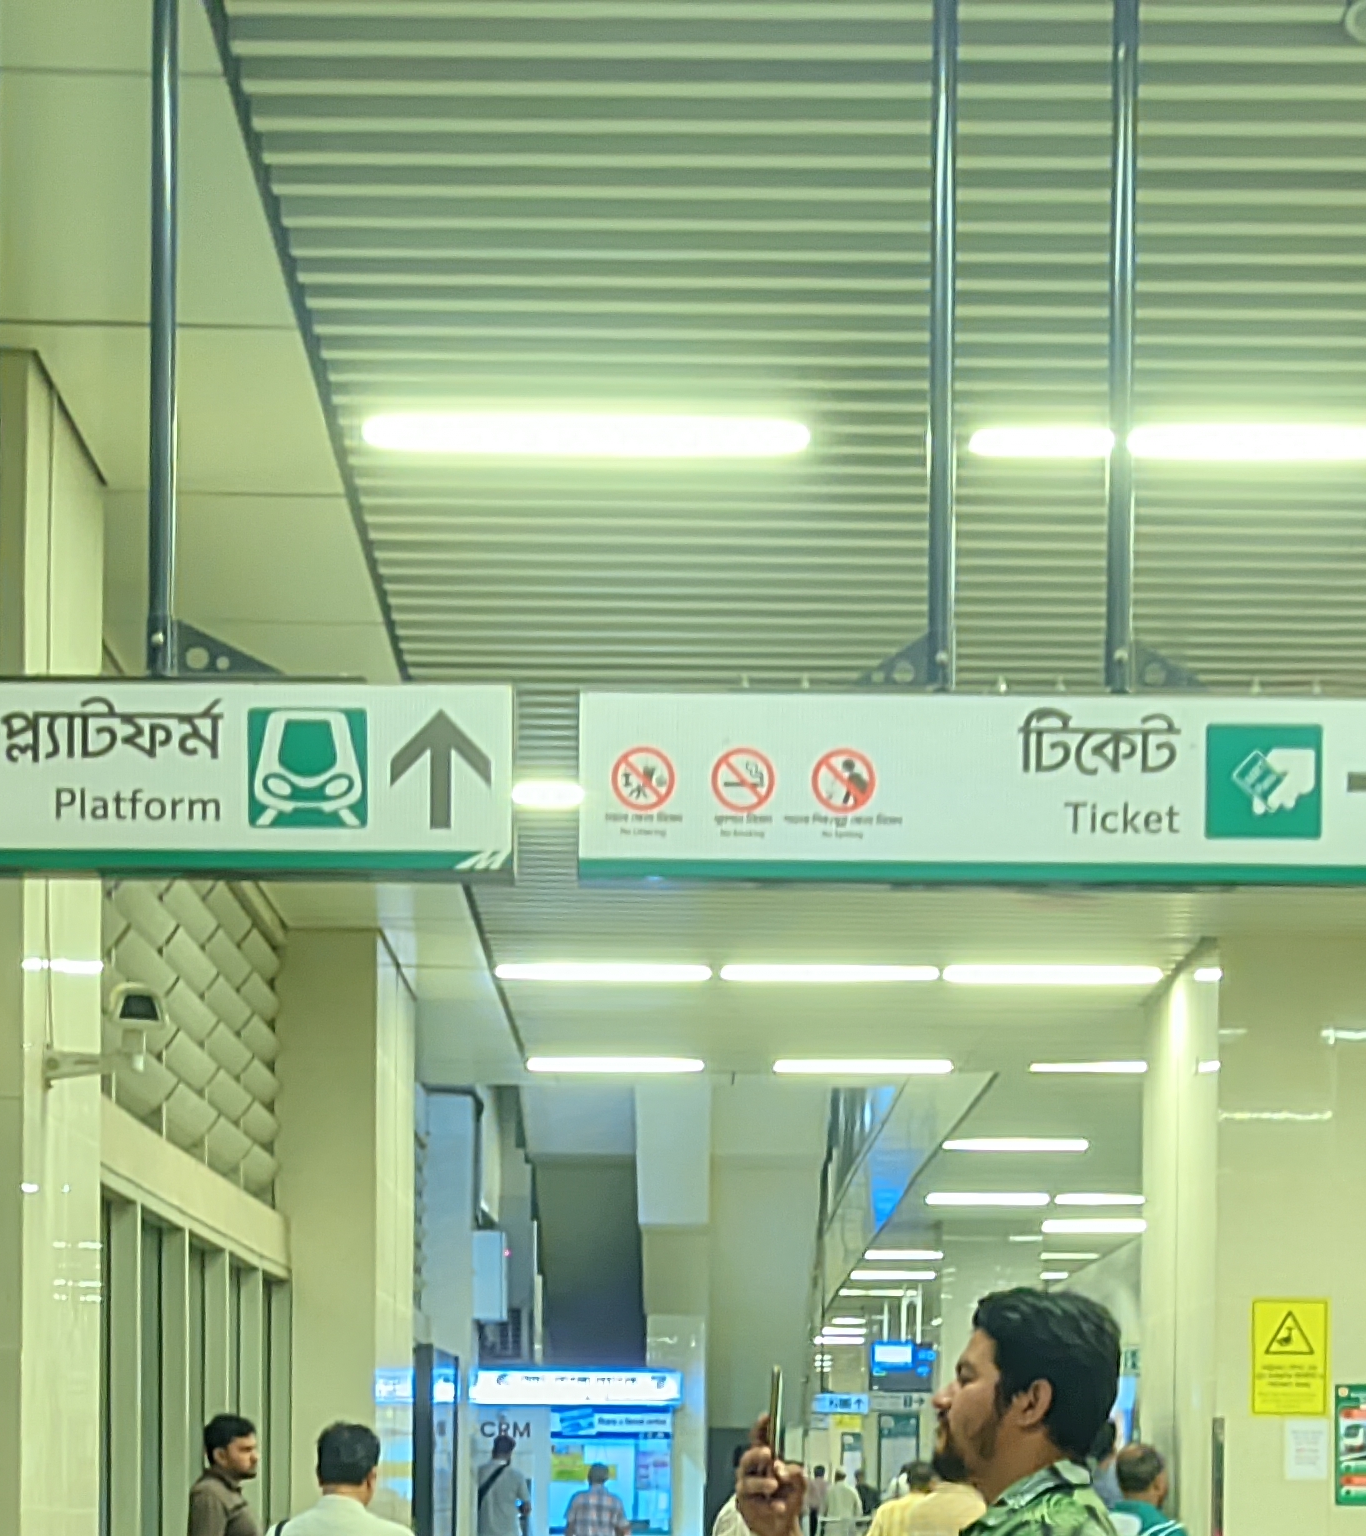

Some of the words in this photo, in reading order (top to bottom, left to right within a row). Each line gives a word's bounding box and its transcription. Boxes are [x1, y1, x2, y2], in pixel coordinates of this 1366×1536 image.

[1, 696, 224, 763] প্ল্যাটফর্ম
[1017, 706, 1182, 776] টিকেট
[55, 787, 221, 822] Platform
[1064, 800, 1181, 834] Ticket
[480, 1420, 531, 1438] CRM
